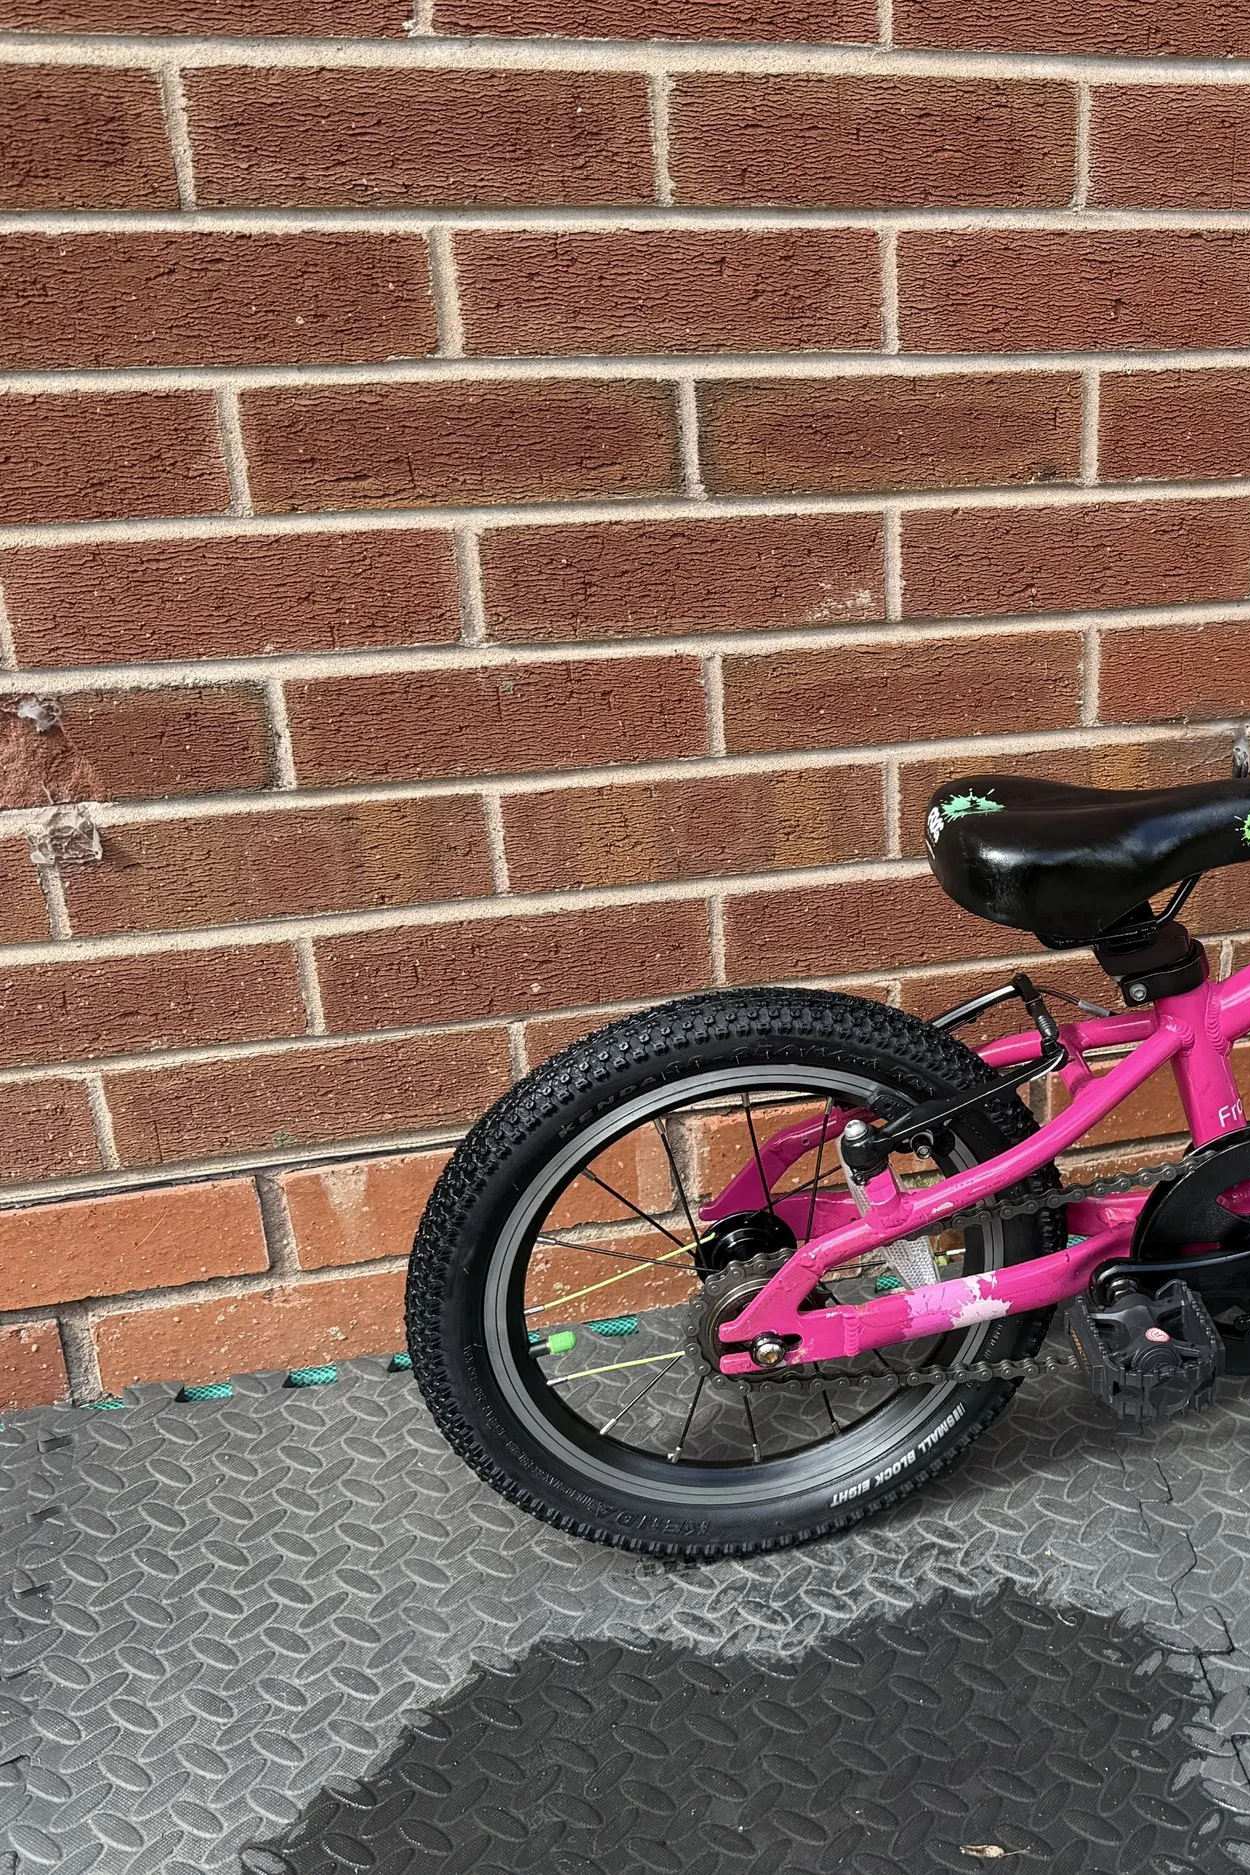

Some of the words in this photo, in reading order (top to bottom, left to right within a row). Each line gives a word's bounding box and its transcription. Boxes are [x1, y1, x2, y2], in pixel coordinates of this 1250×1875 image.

[558, 1075, 658, 1139] KENDA
[917, 1413, 957, 1454] SMALL
[874, 1449, 917, 1488] BLOCK
[830, 1478, 871, 1508] EIGHT
